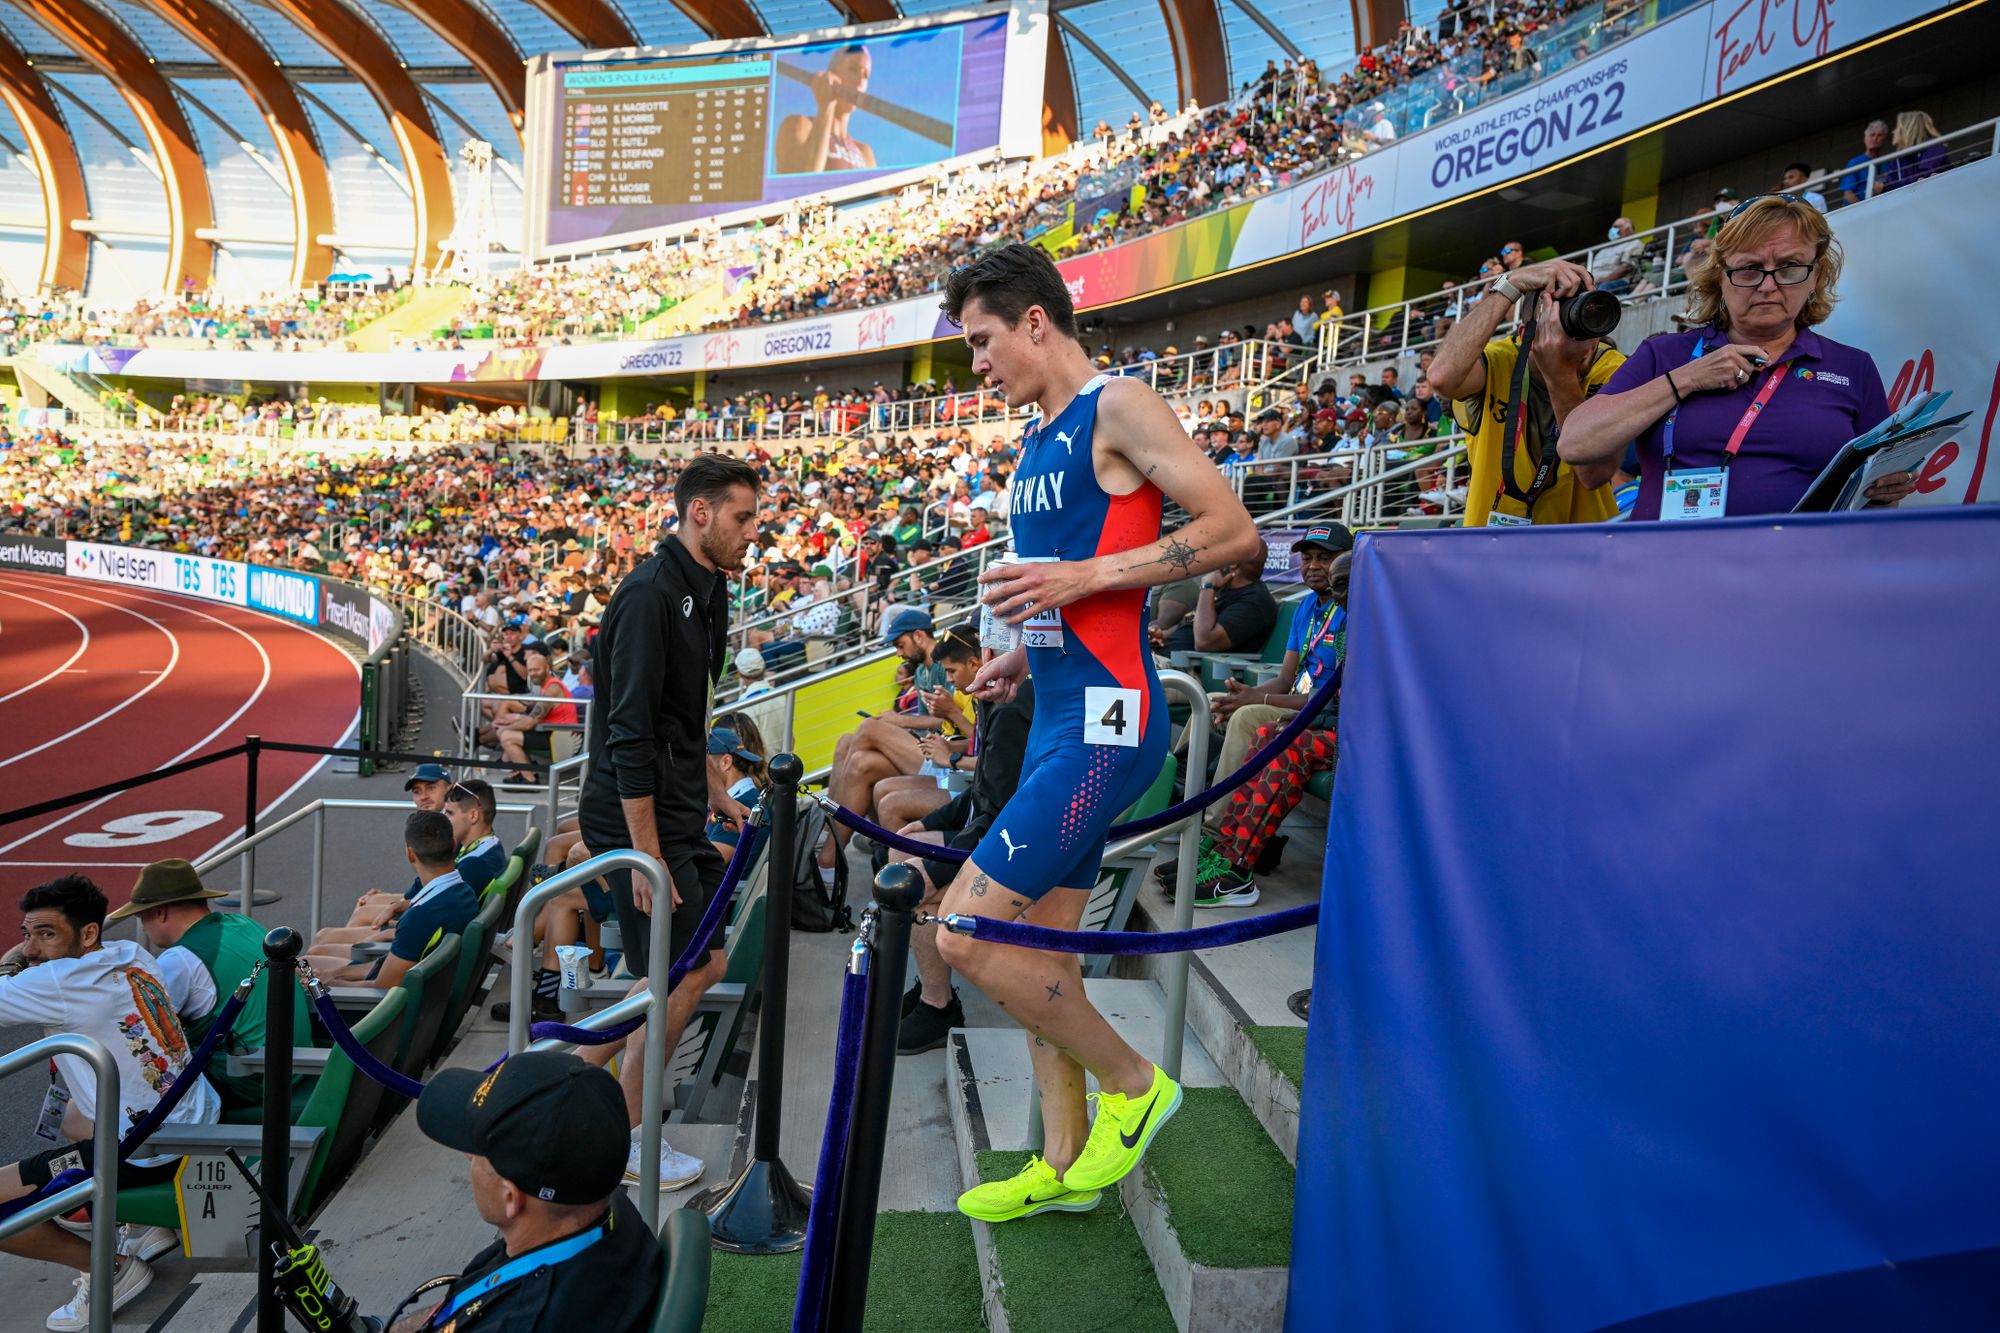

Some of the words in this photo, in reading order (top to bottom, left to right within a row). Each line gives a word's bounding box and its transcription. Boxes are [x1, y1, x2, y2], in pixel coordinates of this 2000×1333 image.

[568, 74, 612, 84] WOMEN'S
[616, 73, 639, 82] POLE
[643, 71, 673, 81] VAULT
[592, 104, 608, 113] USA
[623, 101, 669, 112] NAGEOTTE
[1434, 129, 1470, 152] WORLD
[1472, 104, 1531, 138] ATHLETICS
[1534, 59, 1628, 113] CHAMPIONSHIPS
[566, 116, 573, 125] 2
[592, 116, 608, 124] USA
[622, 114, 655, 124] MORRIS
[566, 129, 572, 137] 3
[590, 128, 607, 136] AUS
[622, 125, 663, 135] KENNEDY
[589, 139, 606, 148] SLO
[621, 137, 648, 147] SUTEJ
[589, 150, 605, 159] GRE
[622, 160, 653, 170] MURTO
[619, 183, 650, 192] MOSER
[587, 196, 605, 204] CAN
[619, 195, 653, 204] NEWELL
[1537, 465, 1548, 480] EOS
[1012, 471, 1064, 515] RWAY
[21, 543, 65, 568] Masons
[99, 549, 157, 582] Nielsen
[1264, 558, 1290, 570] GON22
[175, 557, 200, 591] TBS
[211, 563, 236, 599] TBS
[261, 570, 315, 620] MONDO
[1101, 699, 1126, 735] 4
[63, 810, 225, 848] 9
[196, 1161, 225, 1182] 116
[202, 1191, 216, 1219] A
